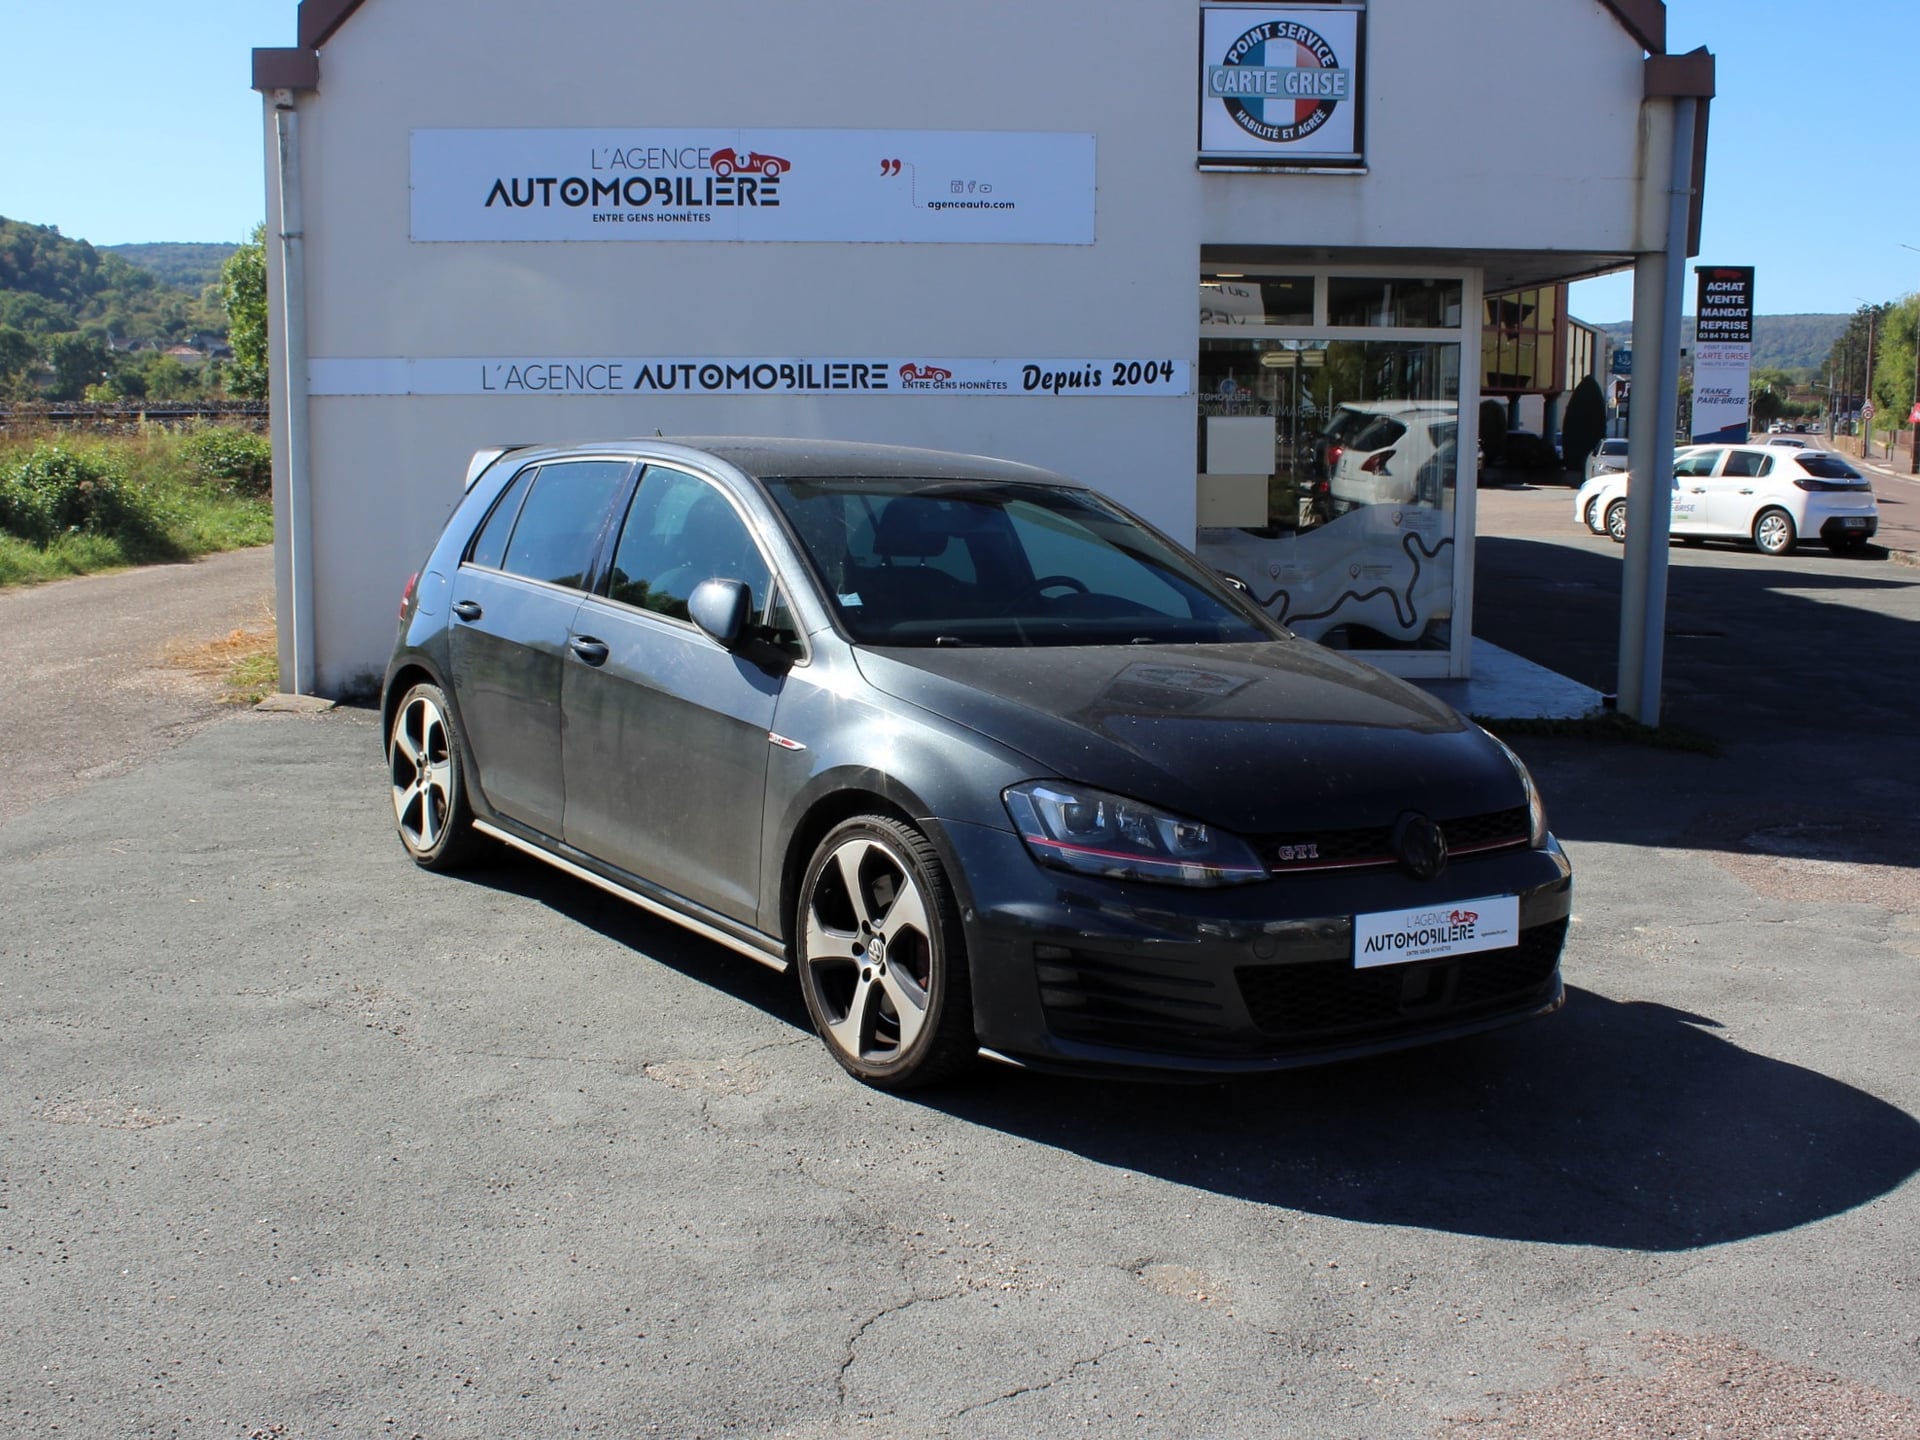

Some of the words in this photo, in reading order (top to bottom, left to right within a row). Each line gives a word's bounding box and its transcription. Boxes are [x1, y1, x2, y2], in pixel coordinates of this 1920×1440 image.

[1227, 24, 1272, 65] POINT
[1277, 23, 1335, 68] SERVICE
[1211, 69, 1278, 94] CARTE
[1284, 71, 1346, 95] GRISE
[1236, 109, 1279, 139] HABILITÉ
[1282, 129, 1295, 139] ET
[1298, 108, 1327, 136] AGRÉÉ
[591, 148, 711, 170] L'AGENCE
[928, 200, 1015, 211] agenceauto.com
[592, 213, 625, 223] ENTRE
[627, 213, 655, 223] GENS
[656, 211, 711, 223] HONNÊTES
[1707, 282, 1745, 291] ACHAT
[1706, 295, 1745, 304] VENTE
[1701, 308, 1749, 317] MANDAT
[1700, 321, 1748, 330] REPRISE
[1697, 352, 1722, 360] CARTE
[1725, 352, 1750, 360] GRISE
[482, 364, 624, 390] L'AGENCE
[1022, 363, 1103, 395] Depuis
[1111, 360, 1175, 386] 2004
[902, 381, 930, 390] ENTRE
[933, 381, 957, 390] GENS
[959, 379, 1008, 390] HONNÊTES
[1700, 387, 1733, 395] FRANCE
[1696, 396, 1746, 405] PARE-BRISE
[1198, 404, 1255, 417] OMMENT
[1279, 844, 1319, 860] GTI
